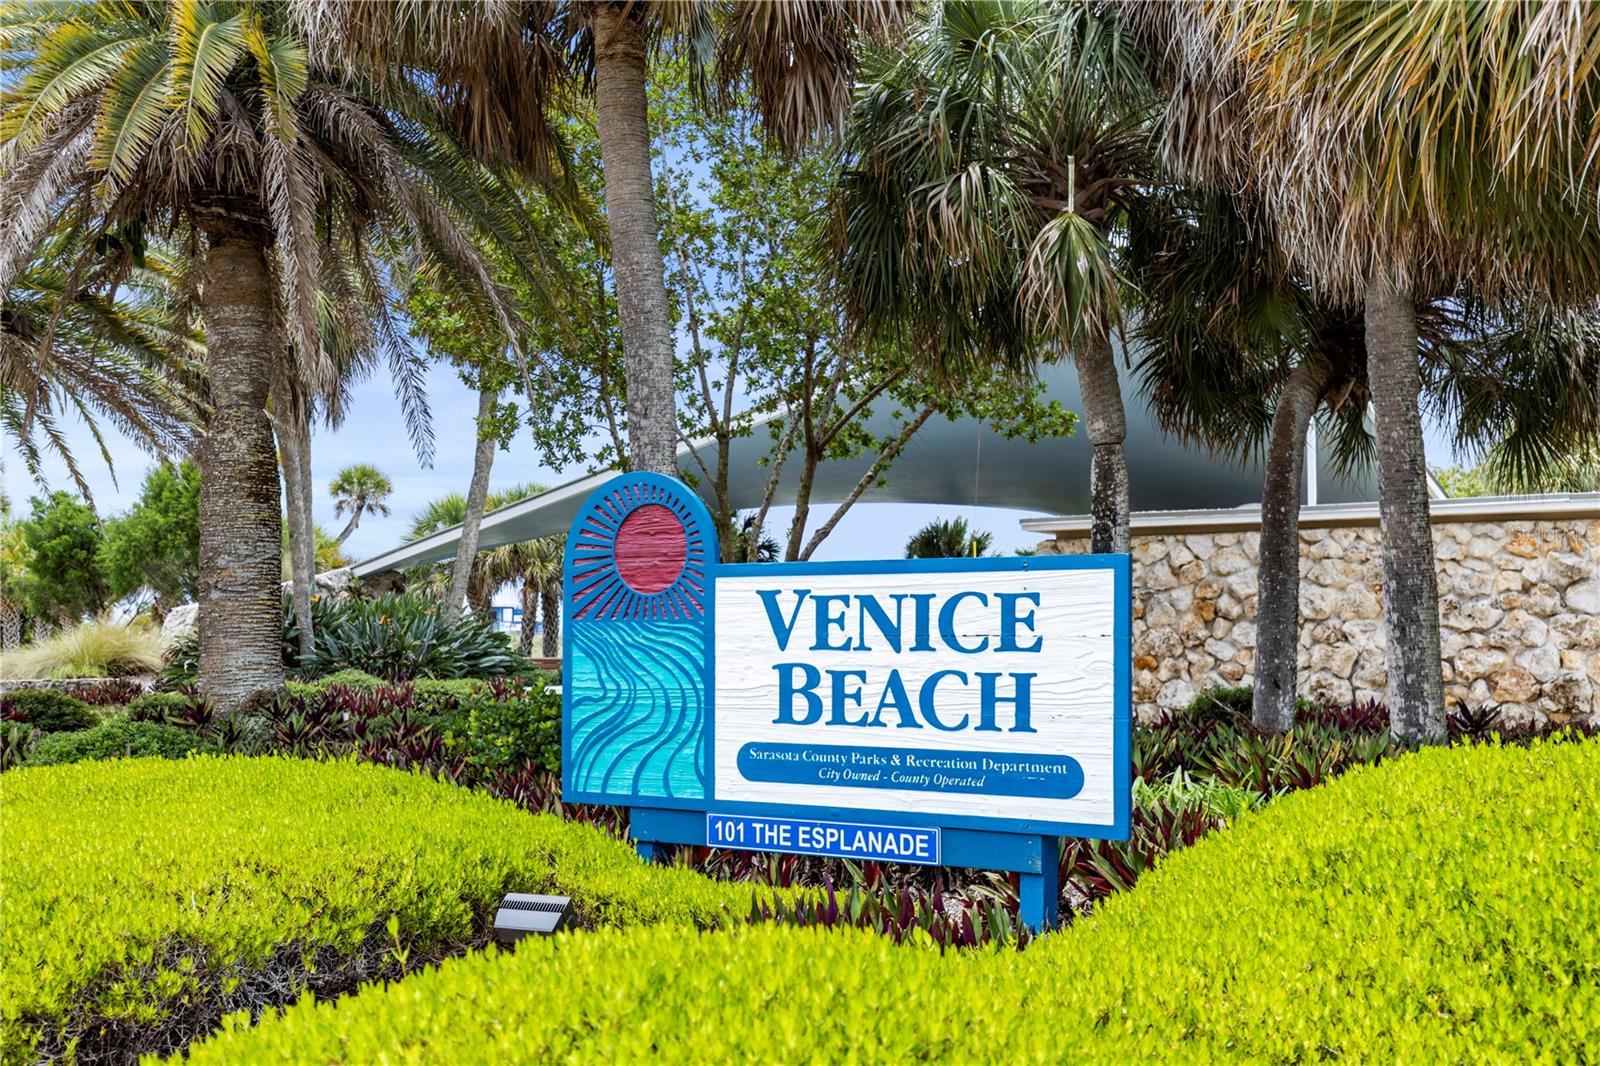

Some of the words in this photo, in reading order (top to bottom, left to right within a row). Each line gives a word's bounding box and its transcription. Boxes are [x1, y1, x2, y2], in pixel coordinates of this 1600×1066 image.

[756, 588, 1042, 654] VENICE
[772, 662, 1038, 733] BEACH
[749, 747, 799, 761] Sarasota
[803, 751, 847, 766] County
[852, 753, 887, 766] Parks
[891, 755, 900, 766] &
[906, 755, 977, 770] Recreation
[982, 758, 1067, 775] Department
[818, 767, 841, 782] City
[842, 769, 881, 782] Owned
[890, 770, 931, 787] County
[932, 773, 985, 788] Operated
[715, 821, 744, 843] 101
[752, 823, 792, 846] THE
[798, 826, 929, 857] ESPLANADE
